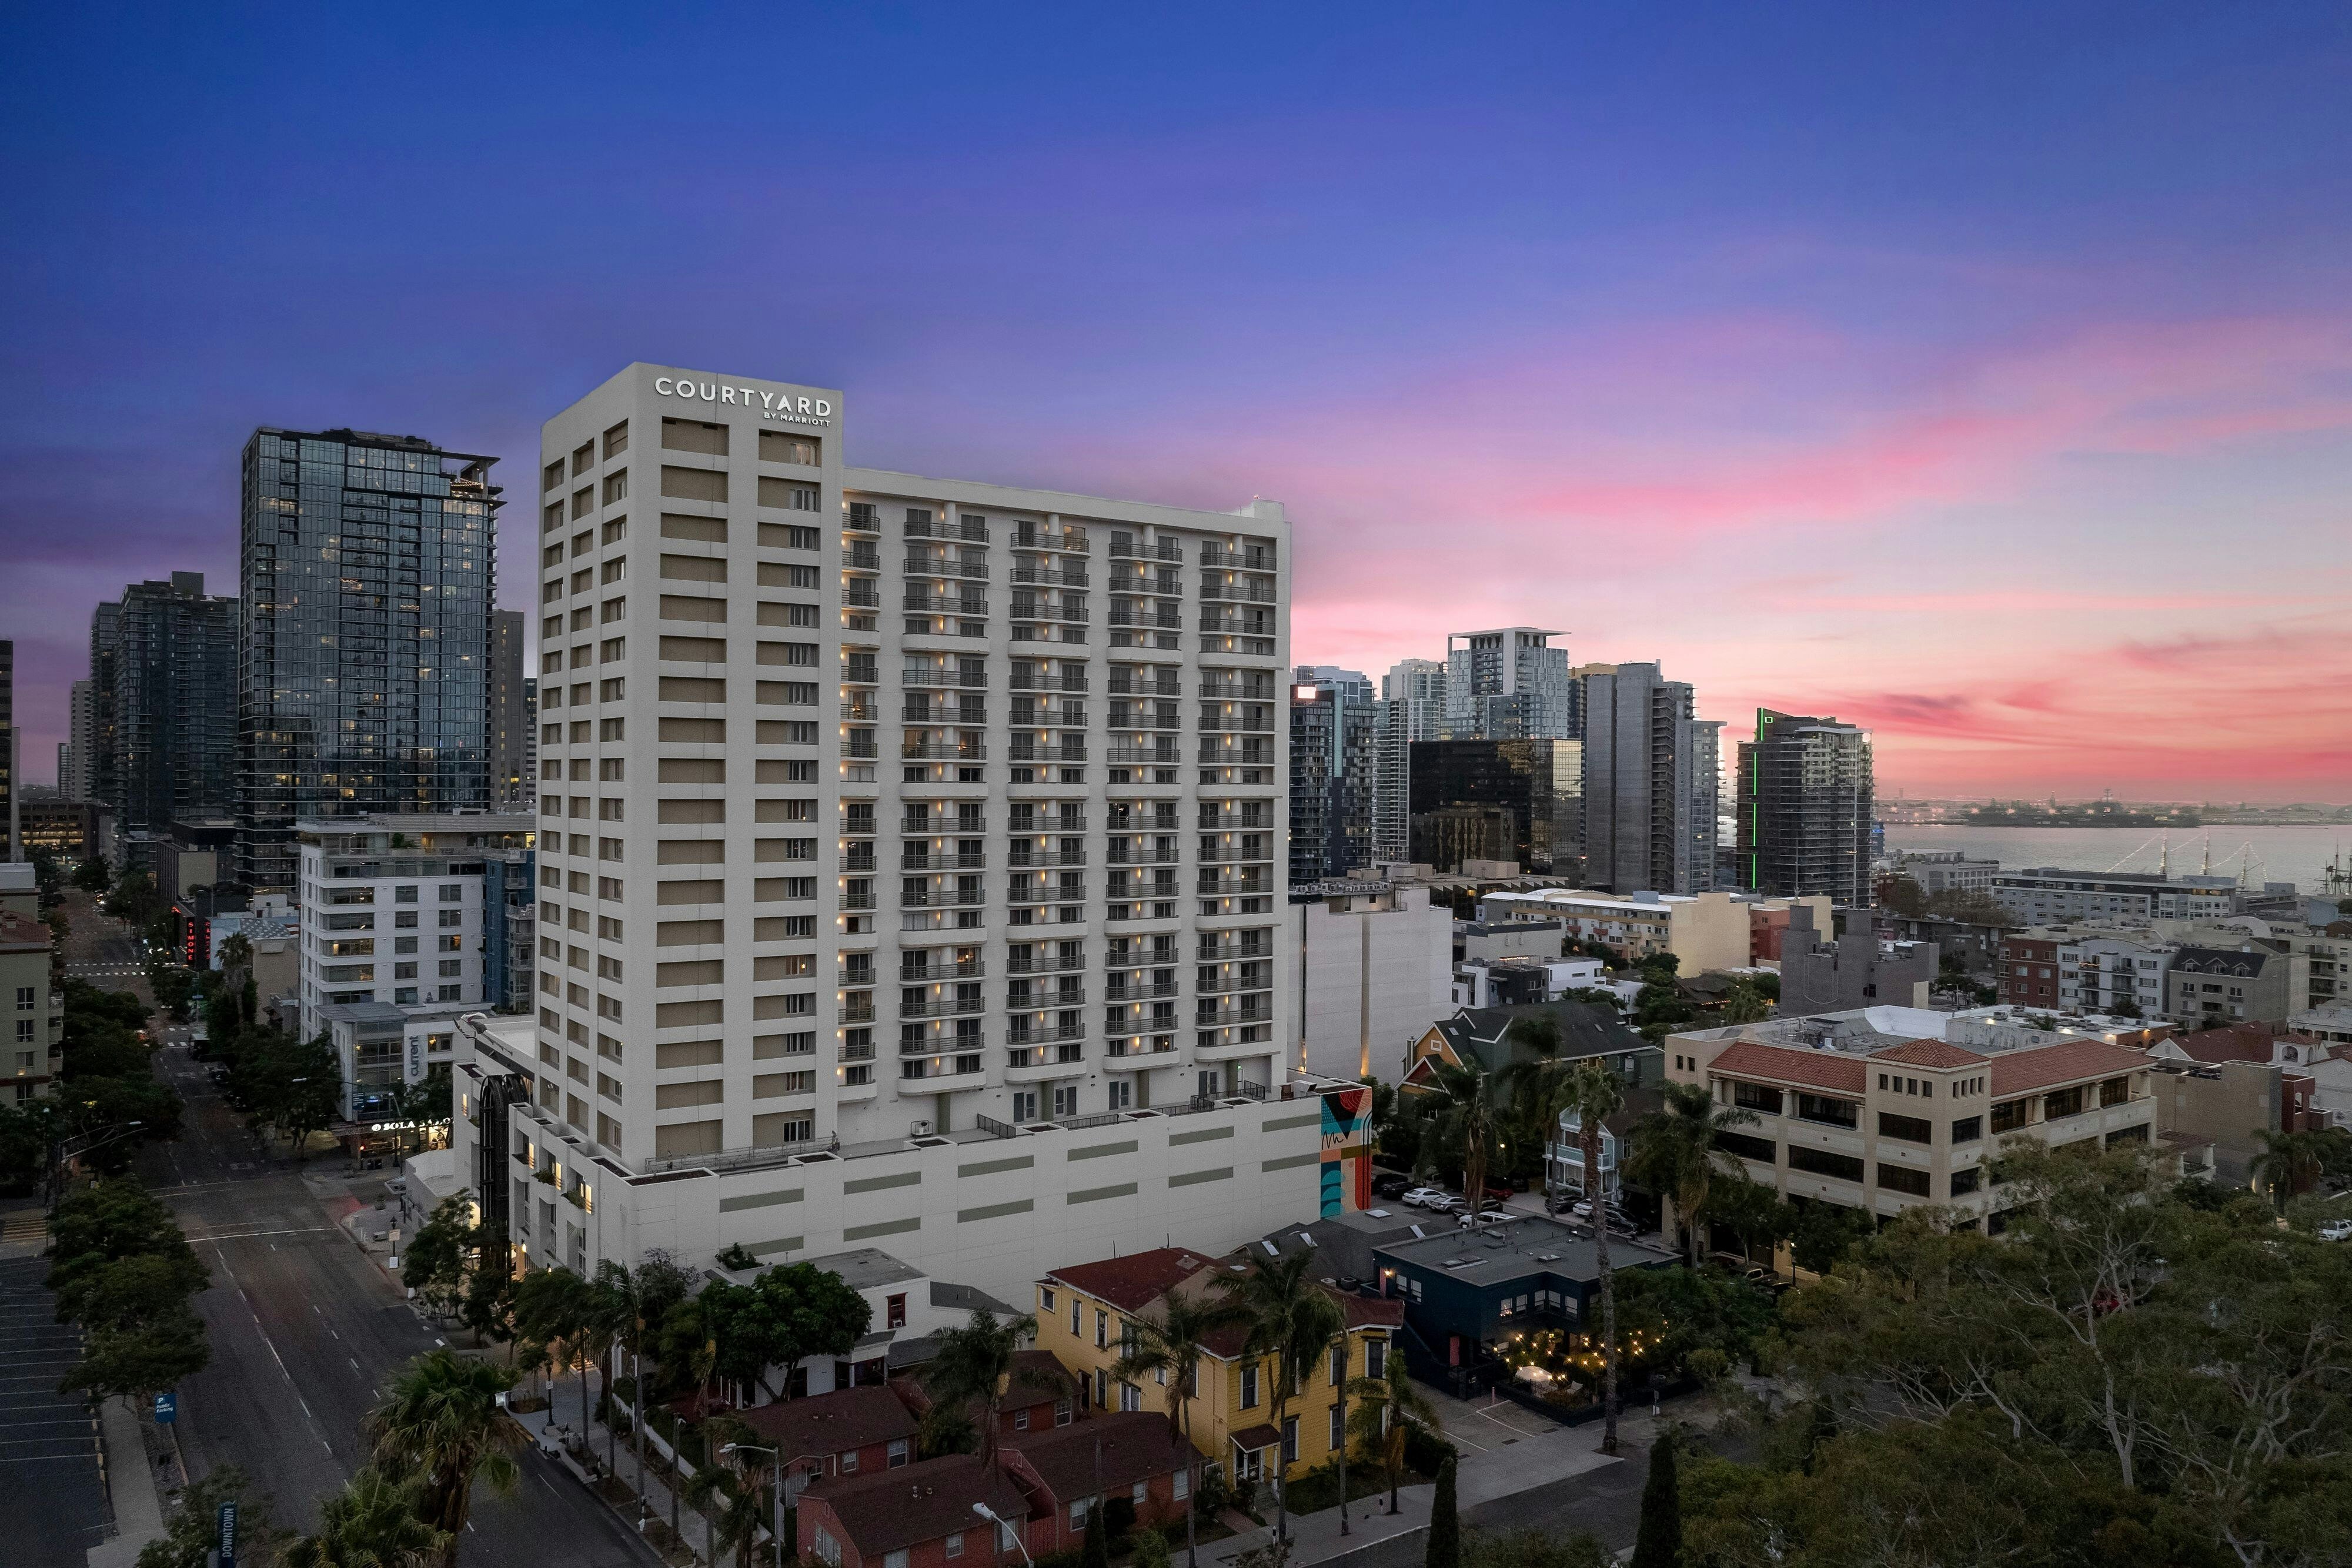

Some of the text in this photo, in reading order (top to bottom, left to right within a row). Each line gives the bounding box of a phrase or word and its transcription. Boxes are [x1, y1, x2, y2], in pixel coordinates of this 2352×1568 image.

[654, 377, 831, 417] COURTYARD
[780, 414, 830, 427] MARRIOTT
[383, 1121, 416, 1130] SOLA
[222, 1508, 235, 1557] DOWNTOWN
